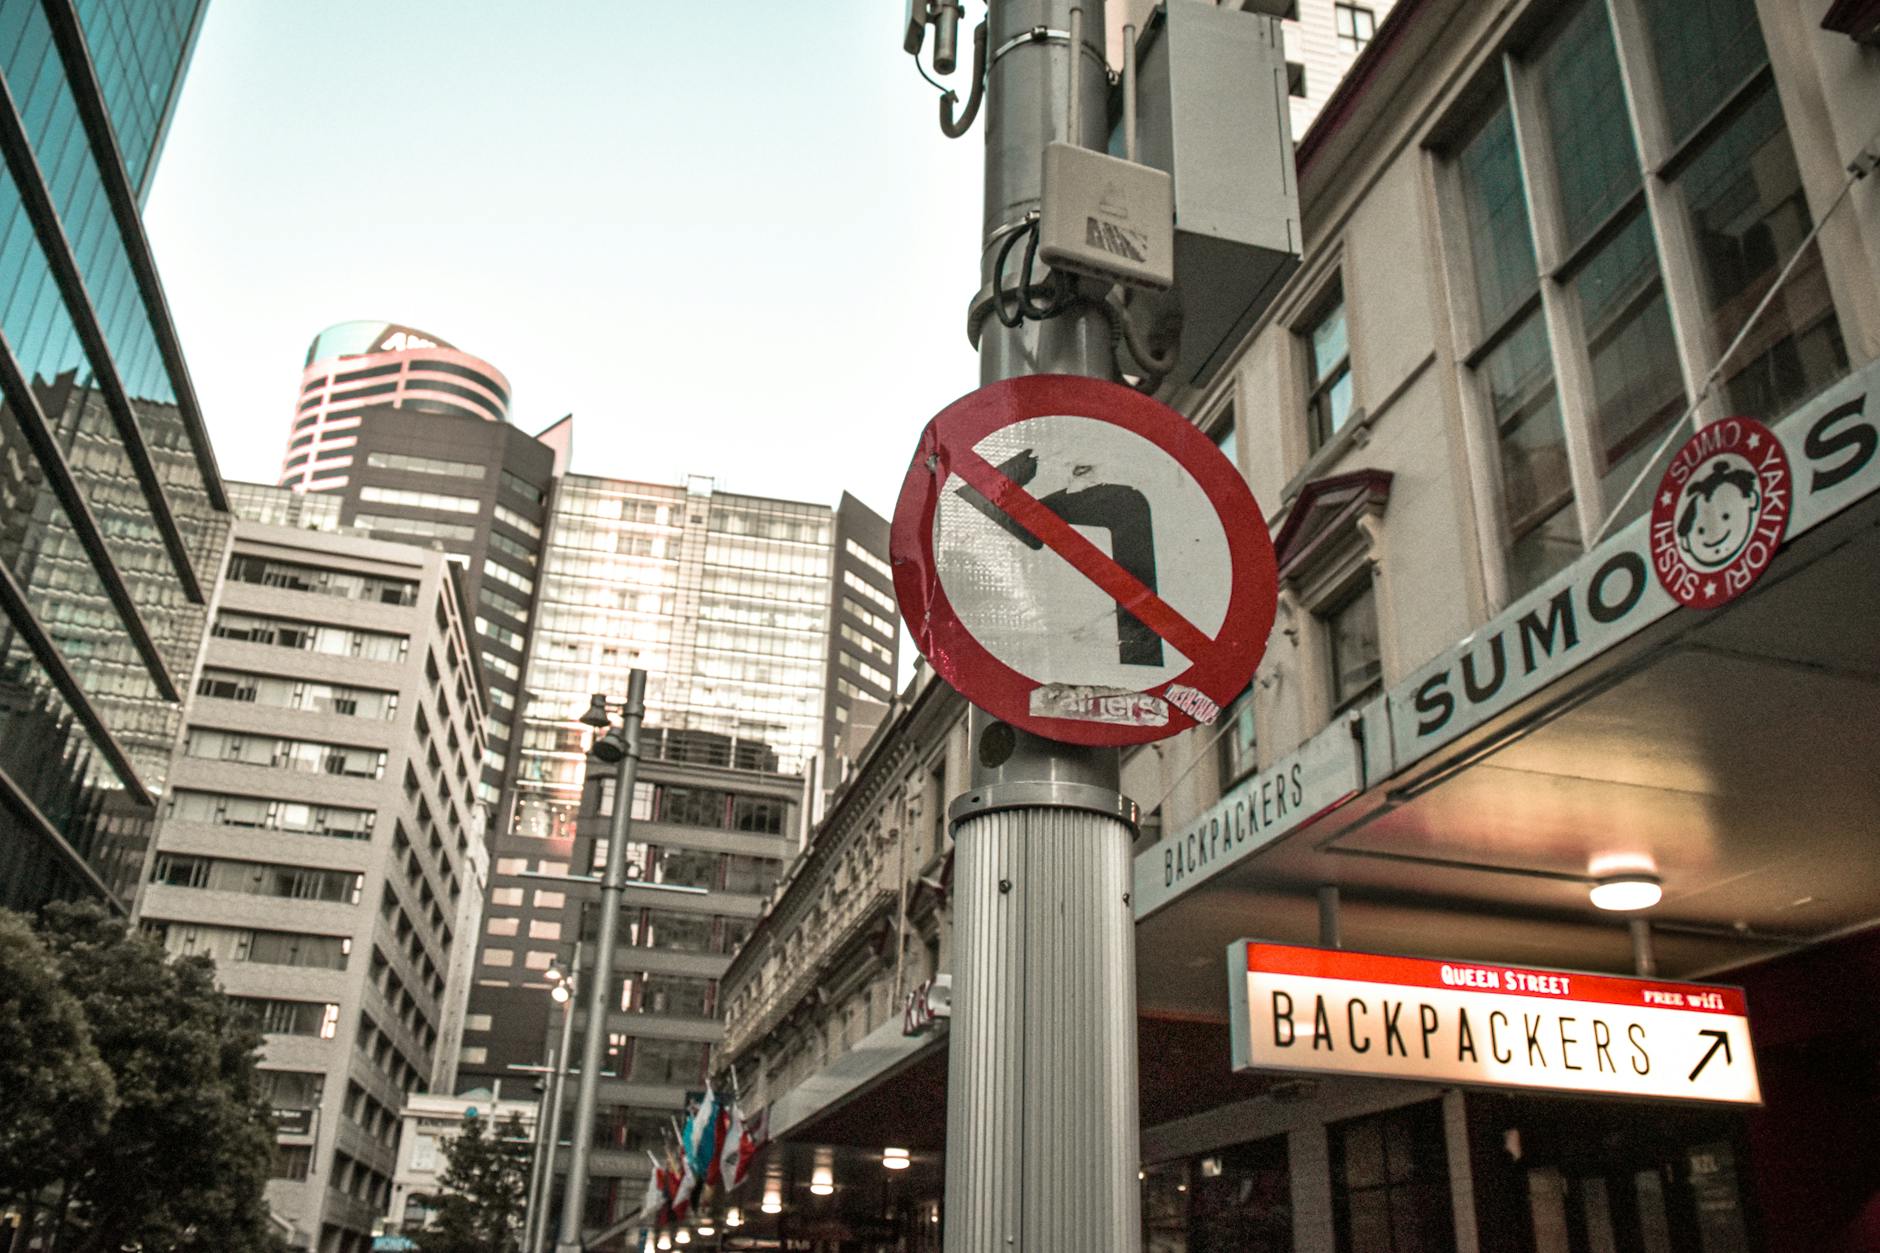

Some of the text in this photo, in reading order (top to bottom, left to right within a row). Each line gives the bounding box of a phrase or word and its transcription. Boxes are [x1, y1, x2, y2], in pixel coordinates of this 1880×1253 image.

[1669, 420, 1741, 484] SUMO
[1653, 520, 1700, 600] SUSHI
[1723, 444, 1788, 597] YAKITORI
[1413, 392, 1879, 737] SUMO S
[1164, 763, 1303, 888] BACKPACKERS
[1441, 964, 1570, 995] QUEEN STREET
[1643, 989, 1725, 1010] FREE wifi
[1272, 990, 1650, 1076] BACKPACKERS
